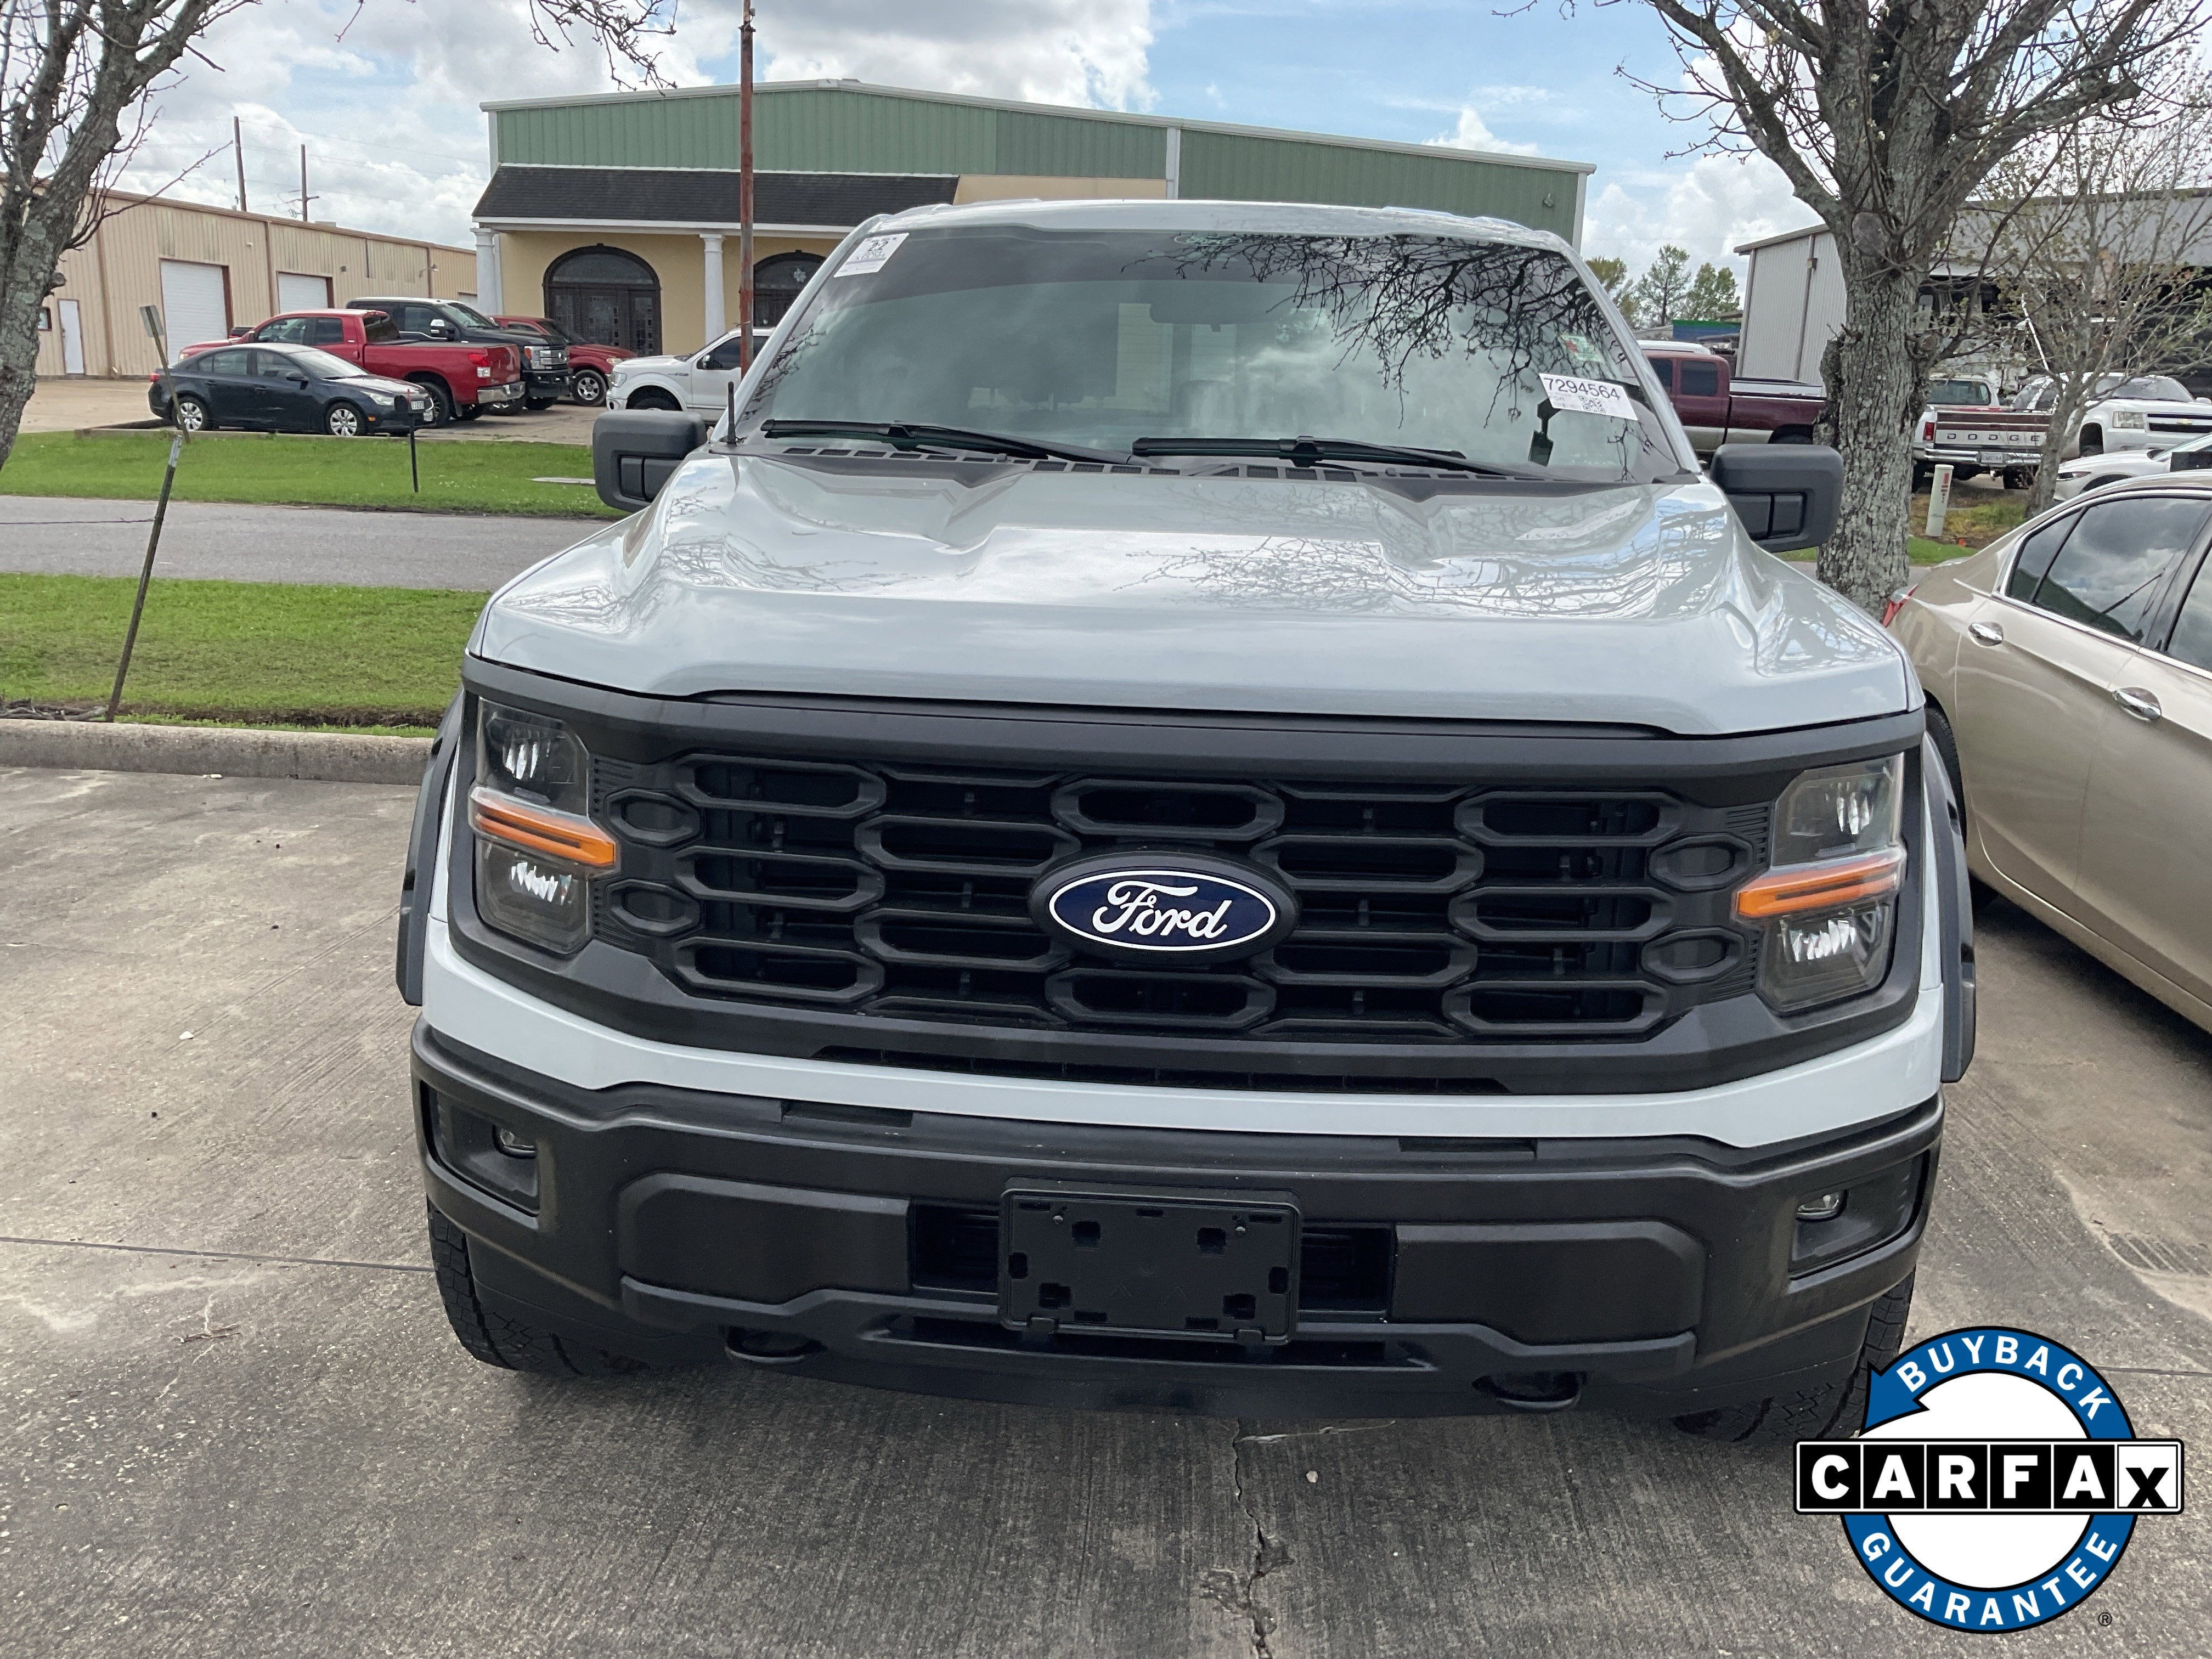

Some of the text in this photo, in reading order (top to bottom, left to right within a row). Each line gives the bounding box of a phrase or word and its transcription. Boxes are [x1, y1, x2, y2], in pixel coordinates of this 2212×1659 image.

[1543, 377, 1620, 400] 7294564
[1947, 433, 2040, 442] DODGE
[1092, 881, 1232, 939] Ford
